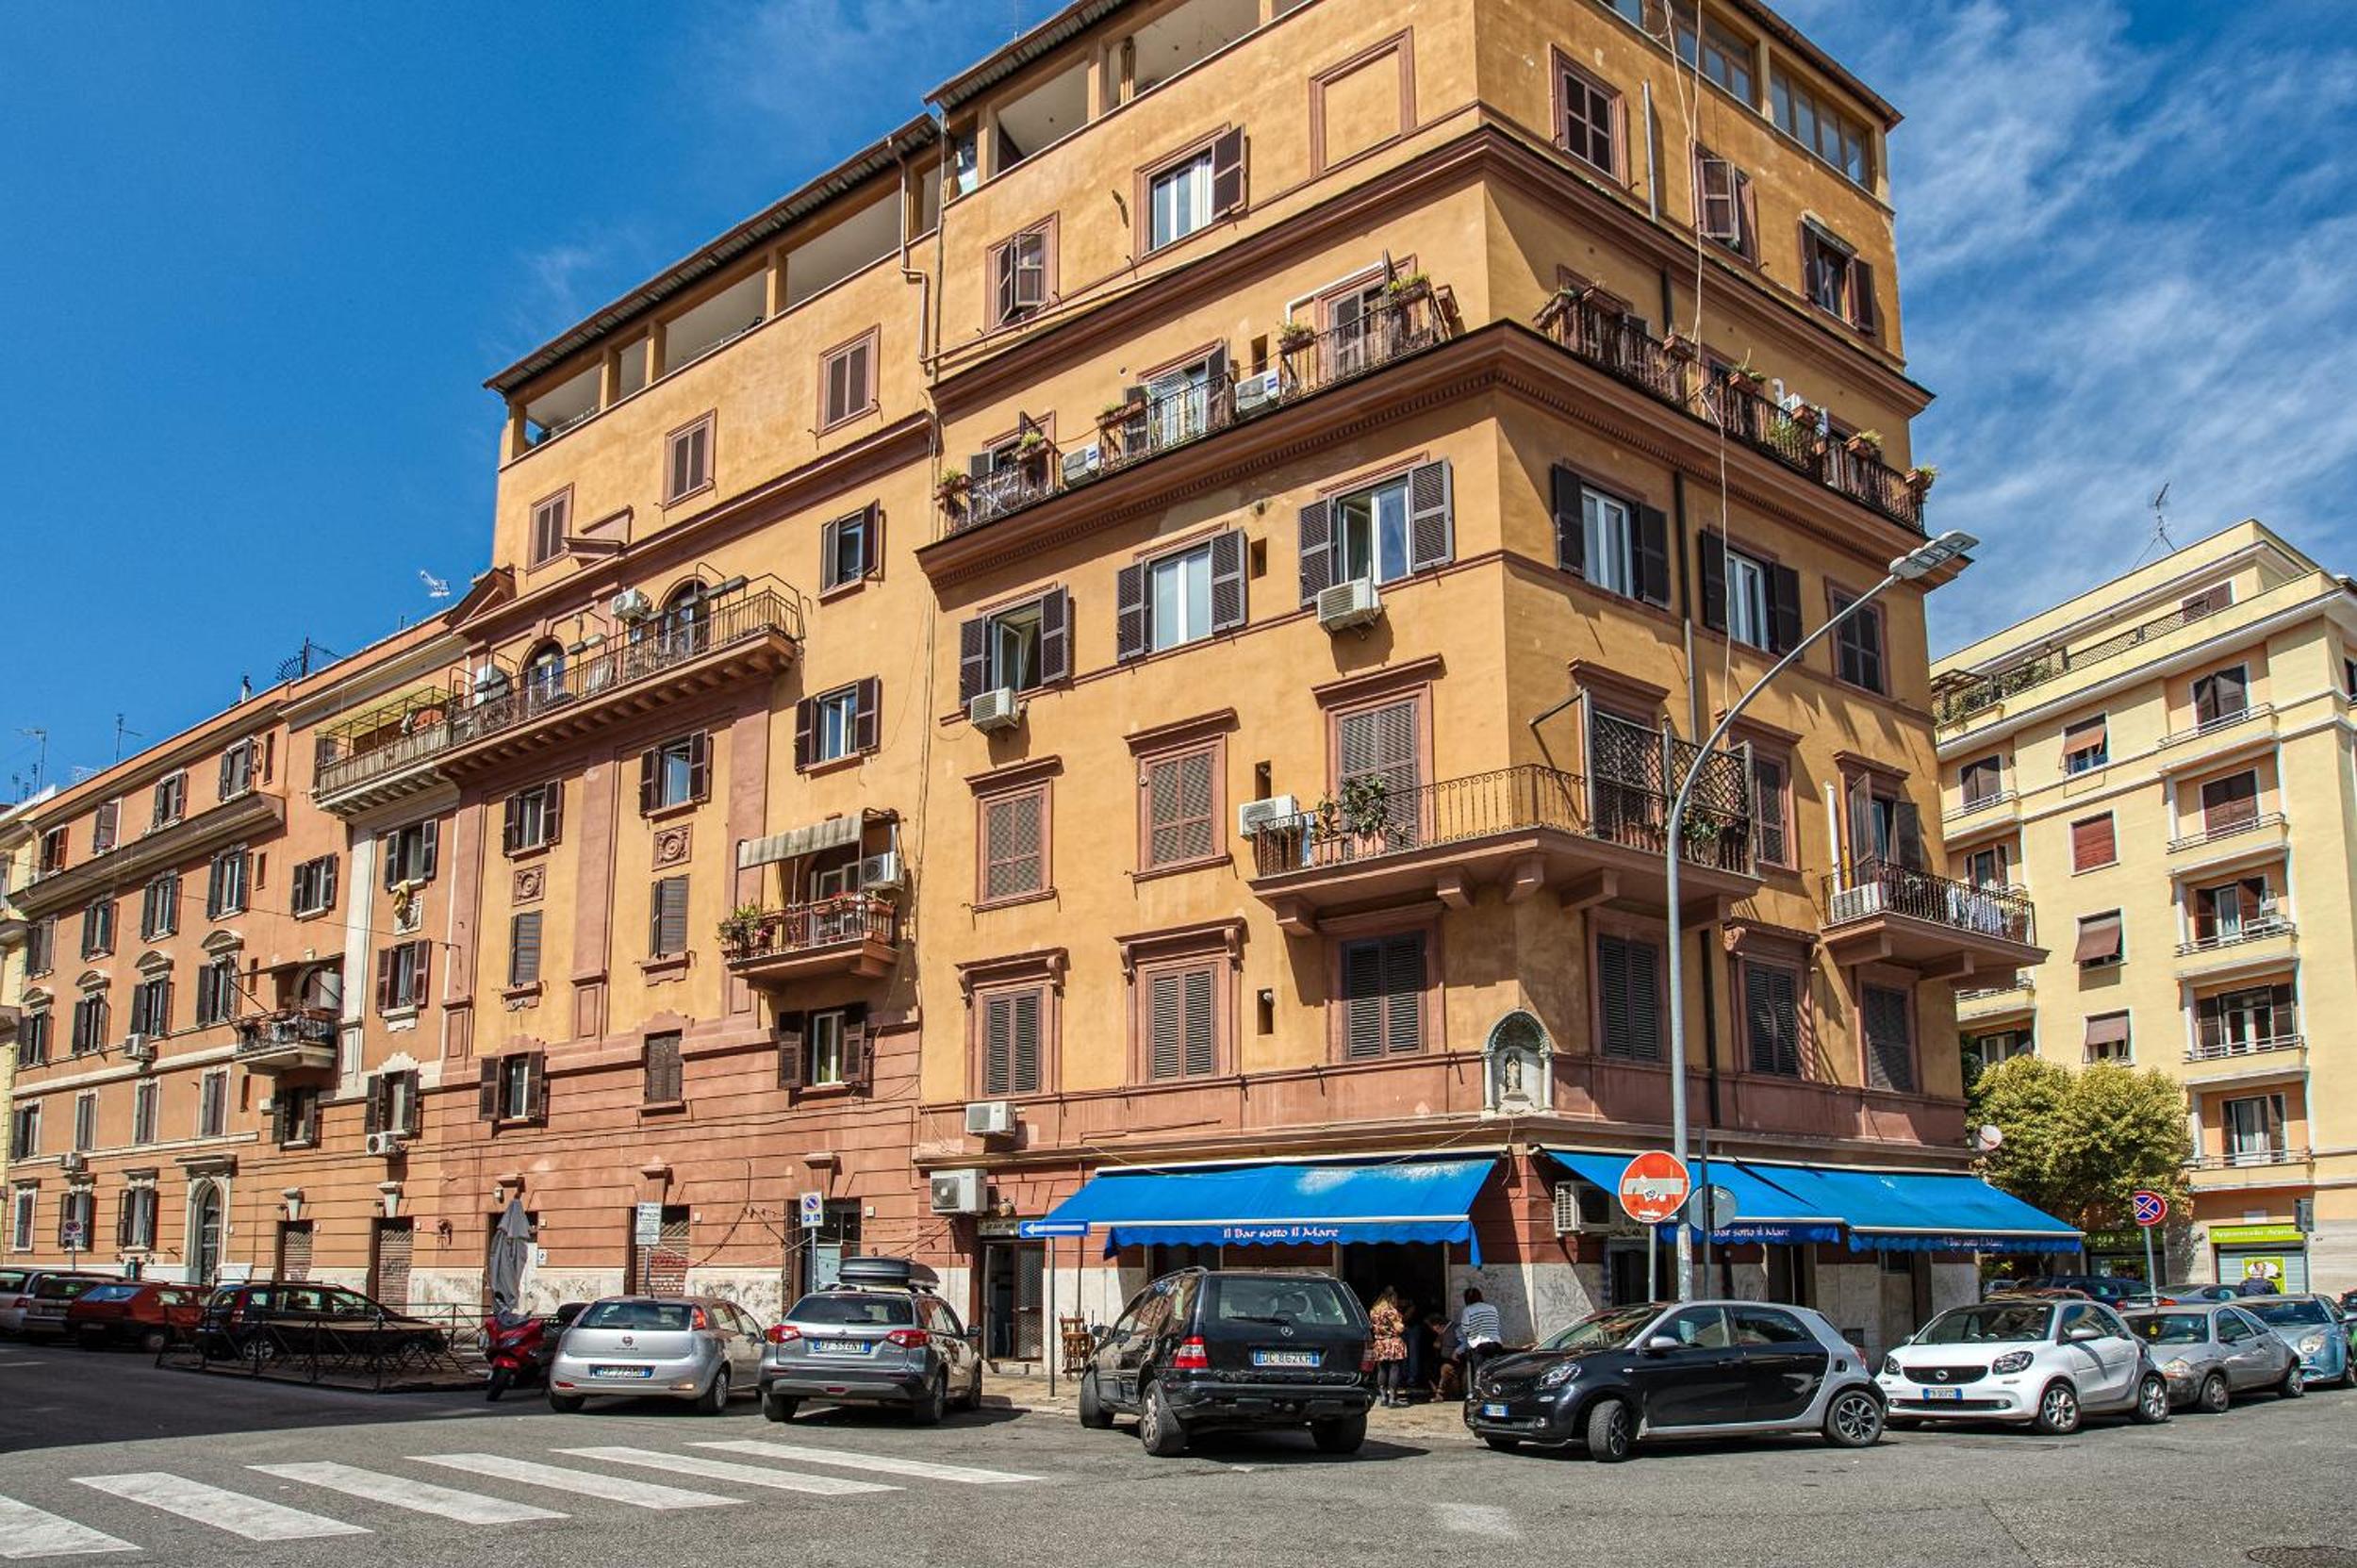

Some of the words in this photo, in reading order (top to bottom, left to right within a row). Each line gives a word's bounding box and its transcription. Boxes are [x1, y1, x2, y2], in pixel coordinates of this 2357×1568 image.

[1234, 1228, 1256, 1238] Bar
[1260, 1228, 1288, 1237] sotto
[1303, 1227, 1339, 1237] Mare
